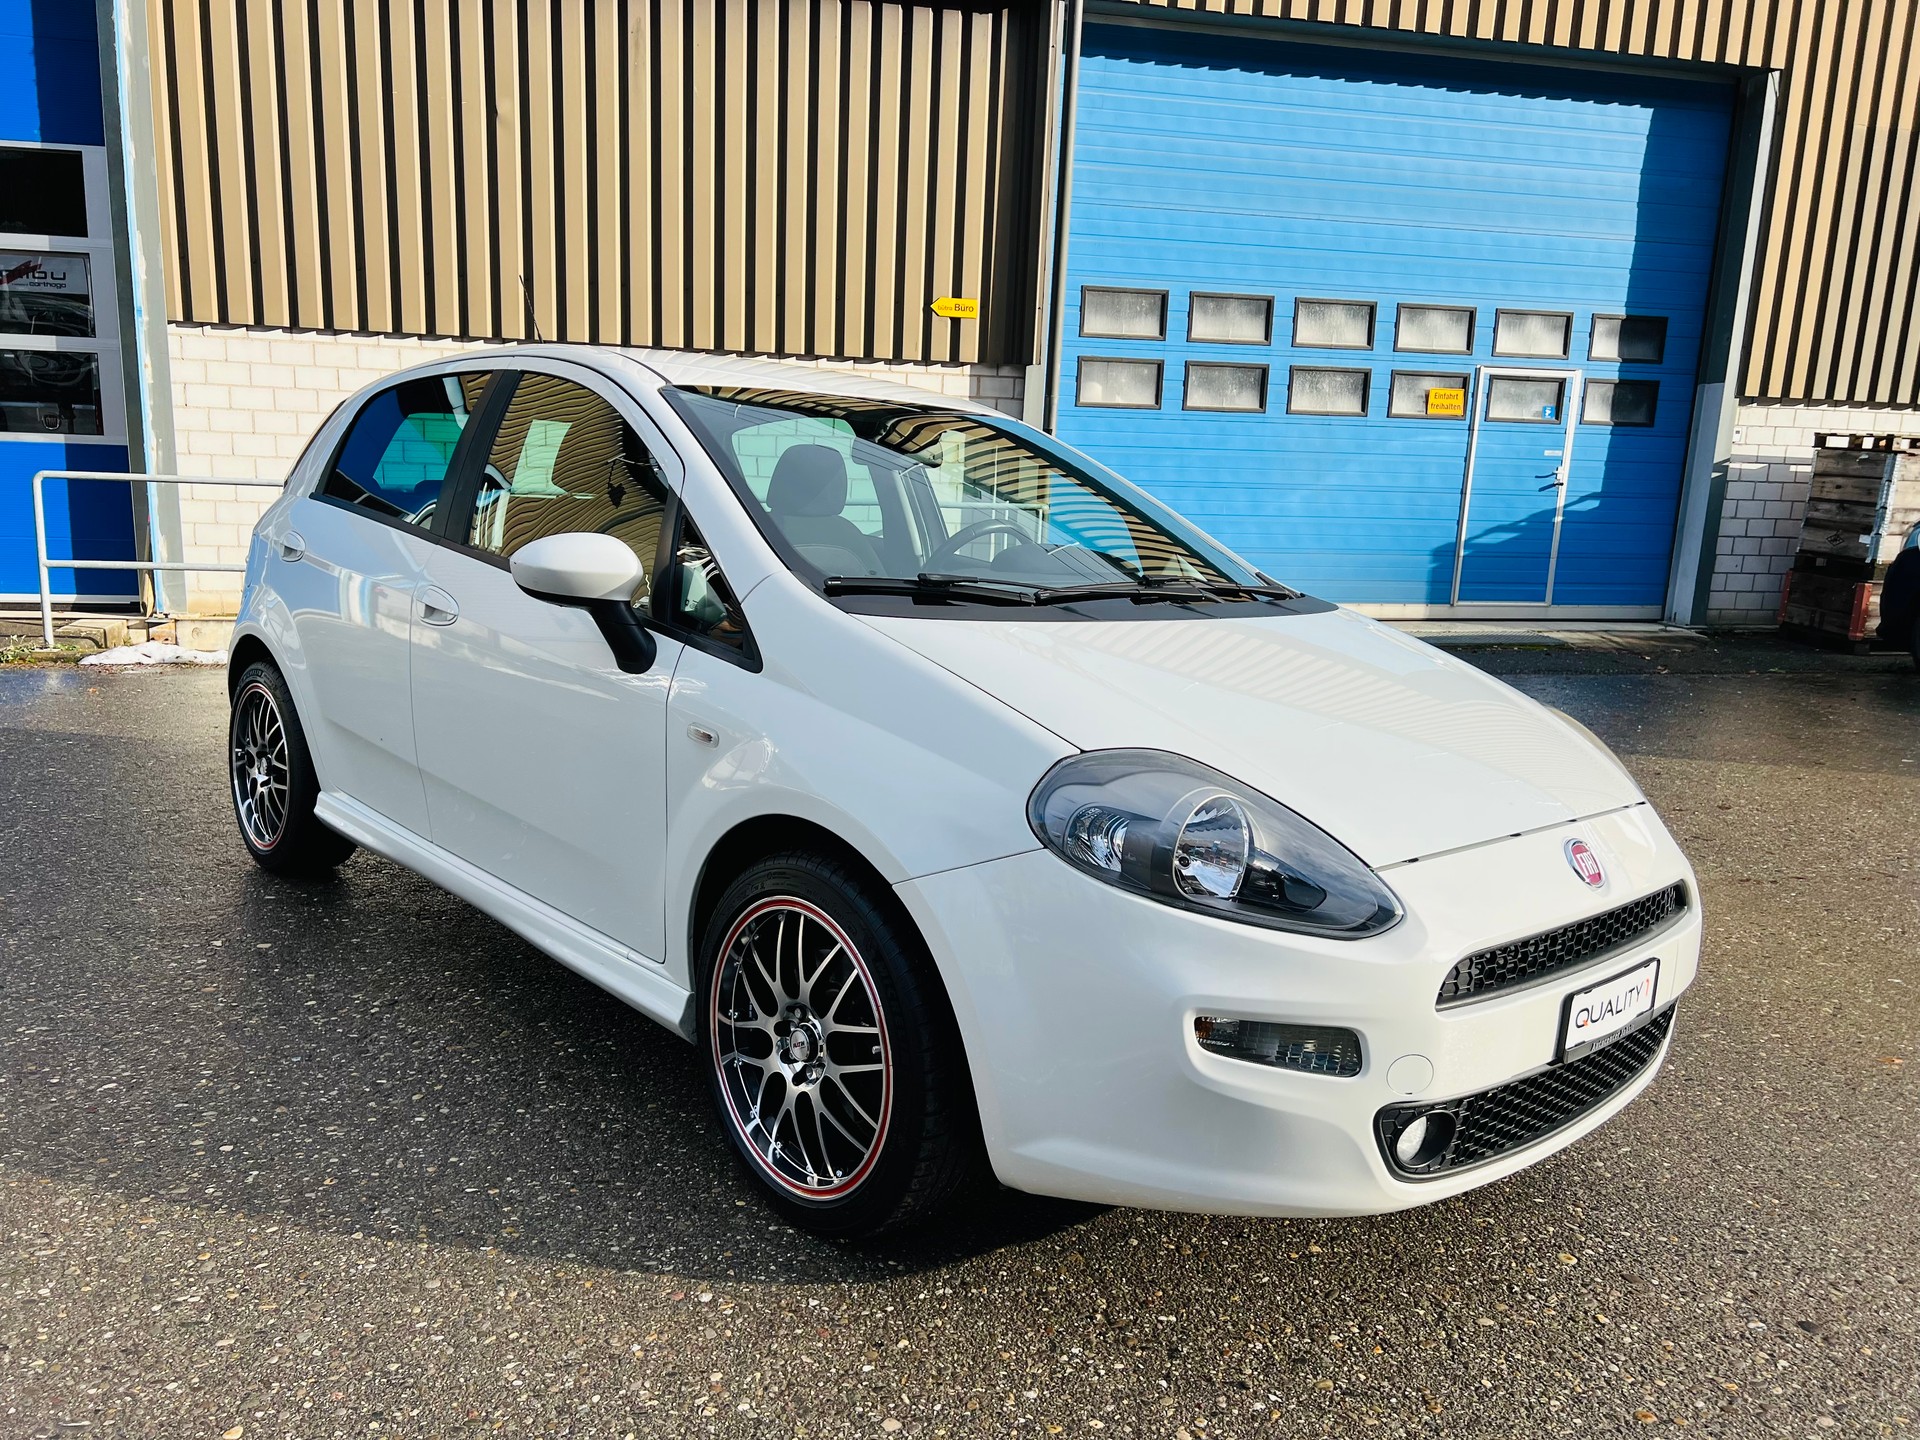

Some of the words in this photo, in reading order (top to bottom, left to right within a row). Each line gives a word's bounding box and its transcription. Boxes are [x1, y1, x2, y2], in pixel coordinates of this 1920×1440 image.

[29, 281, 67, 289] carthago
[954, 303, 974, 312] Büro
[1434, 392, 1459, 400] Einfahrt
[1430, 402, 1461, 410] freihalten
[1575, 851, 1600, 878] FIAT
